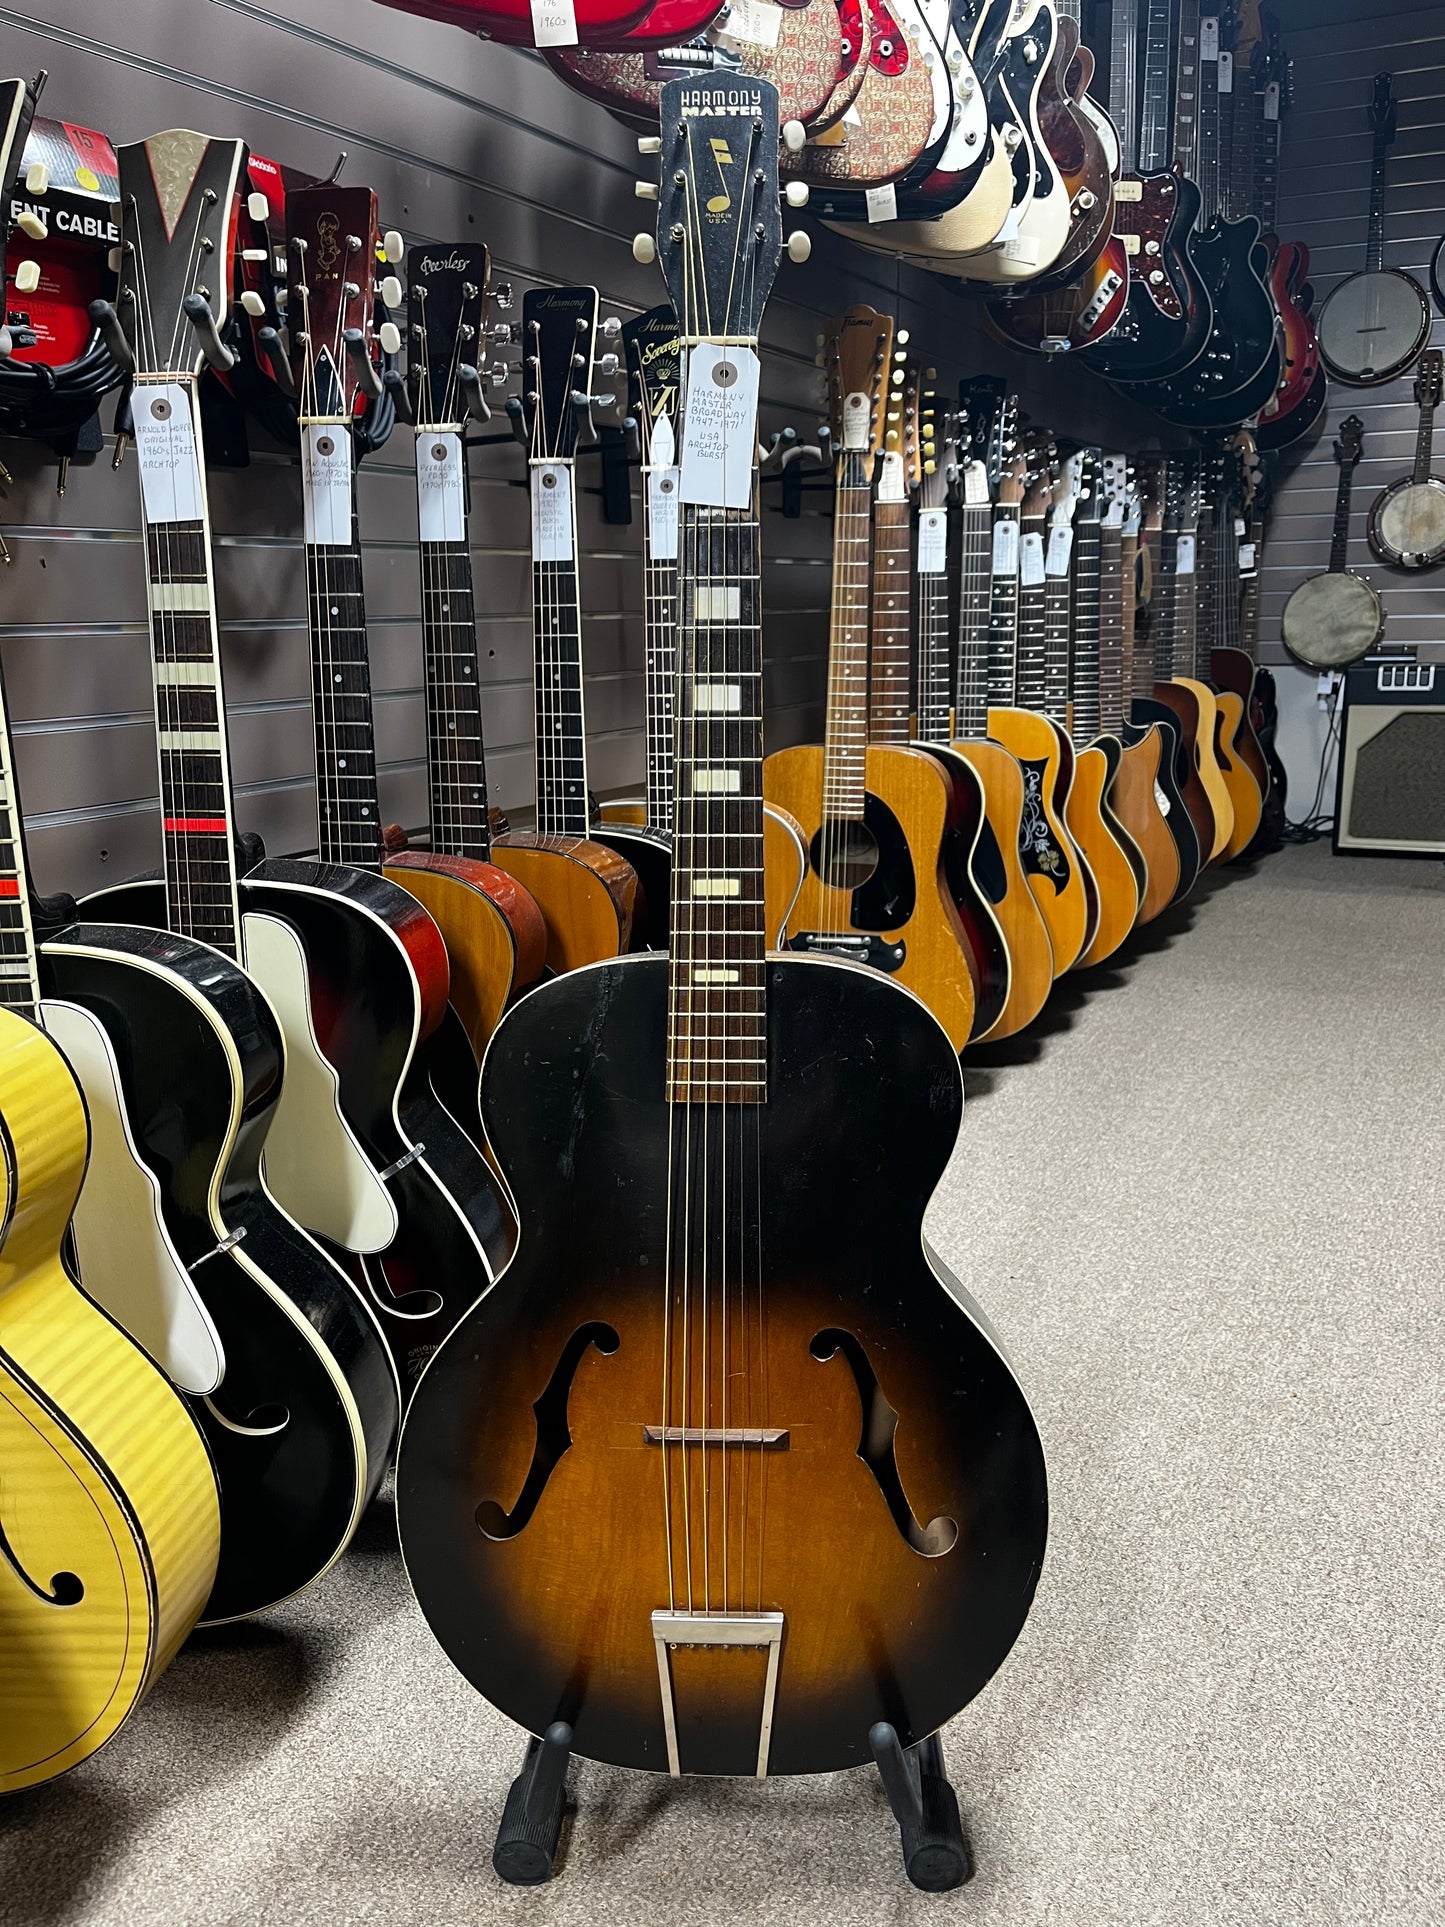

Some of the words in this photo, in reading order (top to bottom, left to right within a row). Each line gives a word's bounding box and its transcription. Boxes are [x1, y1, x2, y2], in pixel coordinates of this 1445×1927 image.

[681, 90, 762, 106] HARMONY
[681, 106, 763, 117] MASTER
[72, 130, 94, 149] 15
[56, 210, 120, 242] CABLE
[420, 250, 471, 276] Peerless
[315, 273, 339, 281] PAN
[536, 294, 588, 311] Harmony
[638, 318, 680, 333] Harmo
[641, 336, 681, 365] Sovereig
[692, 386, 745, 402] HARMONY
[691, 397, 732, 410] MASTER
[137, 425, 167, 434] ARNOLD
[700, 431, 720, 441] USA
[144, 435, 184, 444] ORIGINAL
